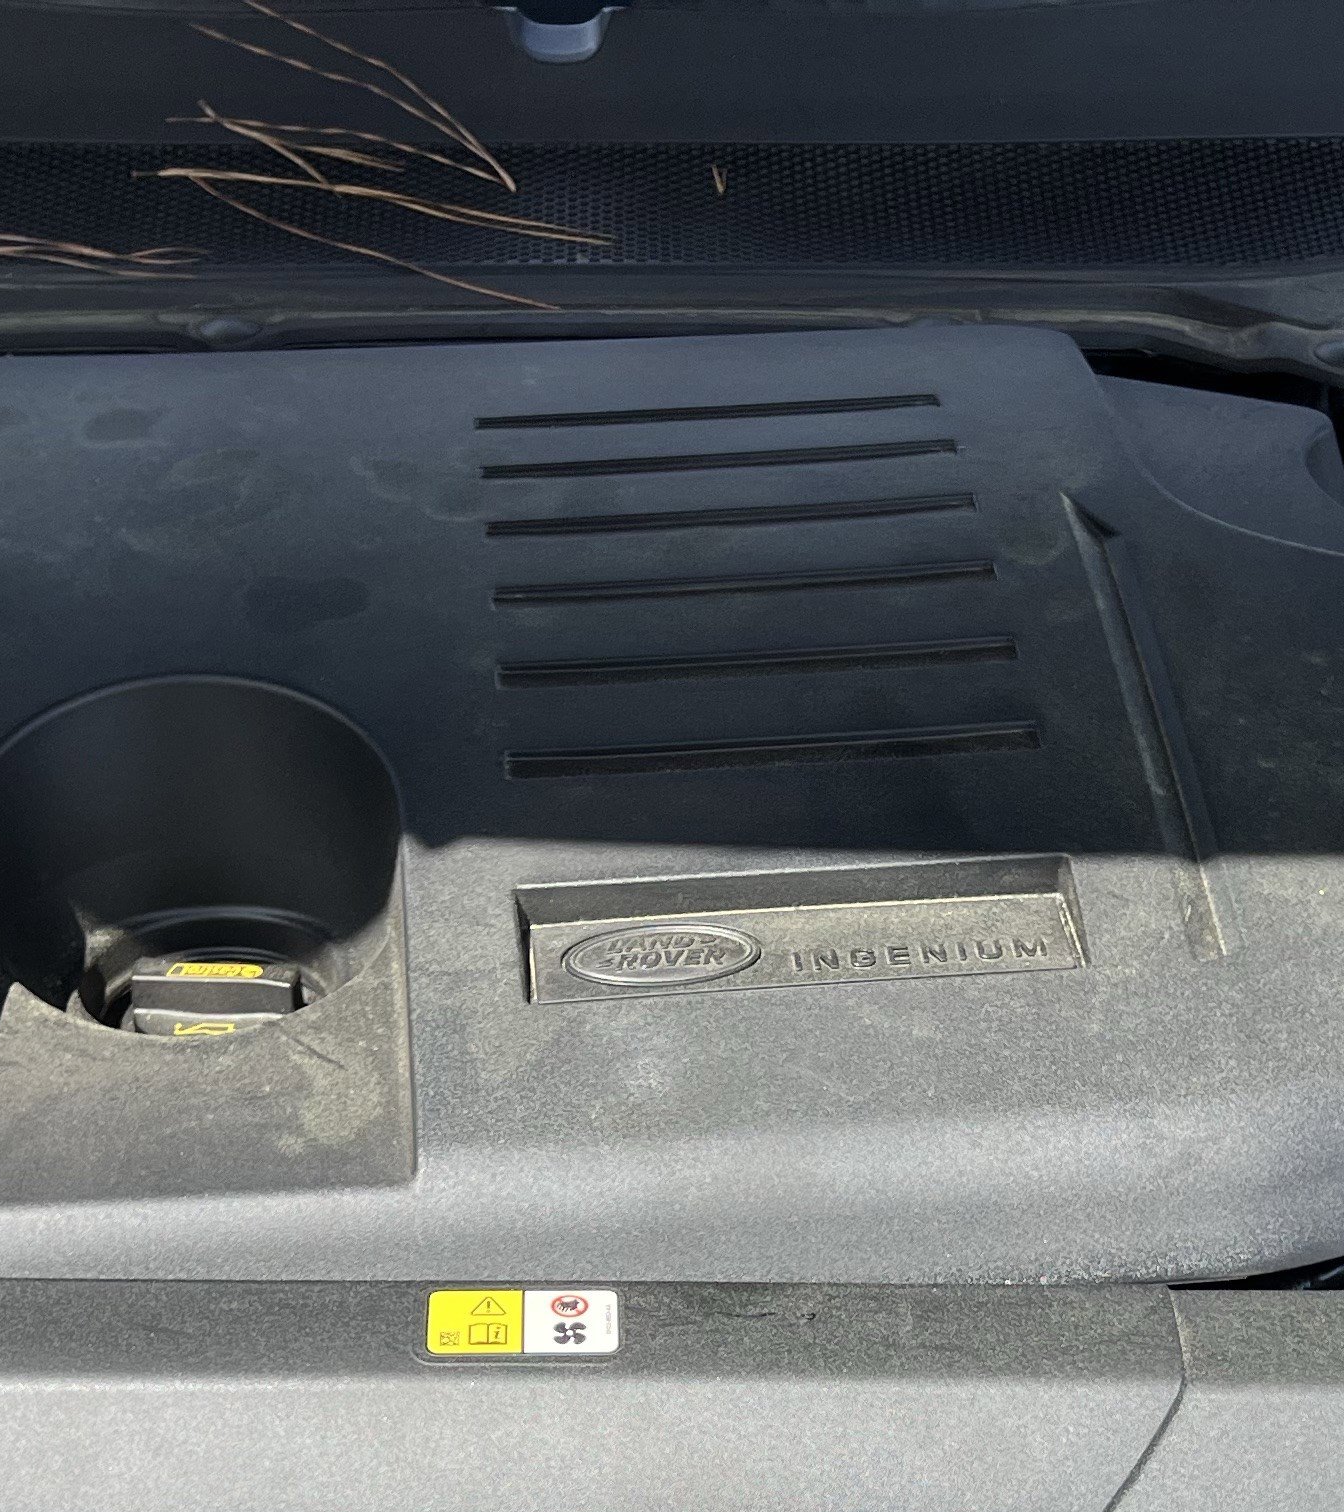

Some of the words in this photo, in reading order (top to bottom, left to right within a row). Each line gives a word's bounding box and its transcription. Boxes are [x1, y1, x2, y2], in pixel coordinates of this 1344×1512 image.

[608, 935, 694, 955] LAND
[790, 938, 1048, 972] INGENIUM
[617, 948, 727, 972] ROVER
